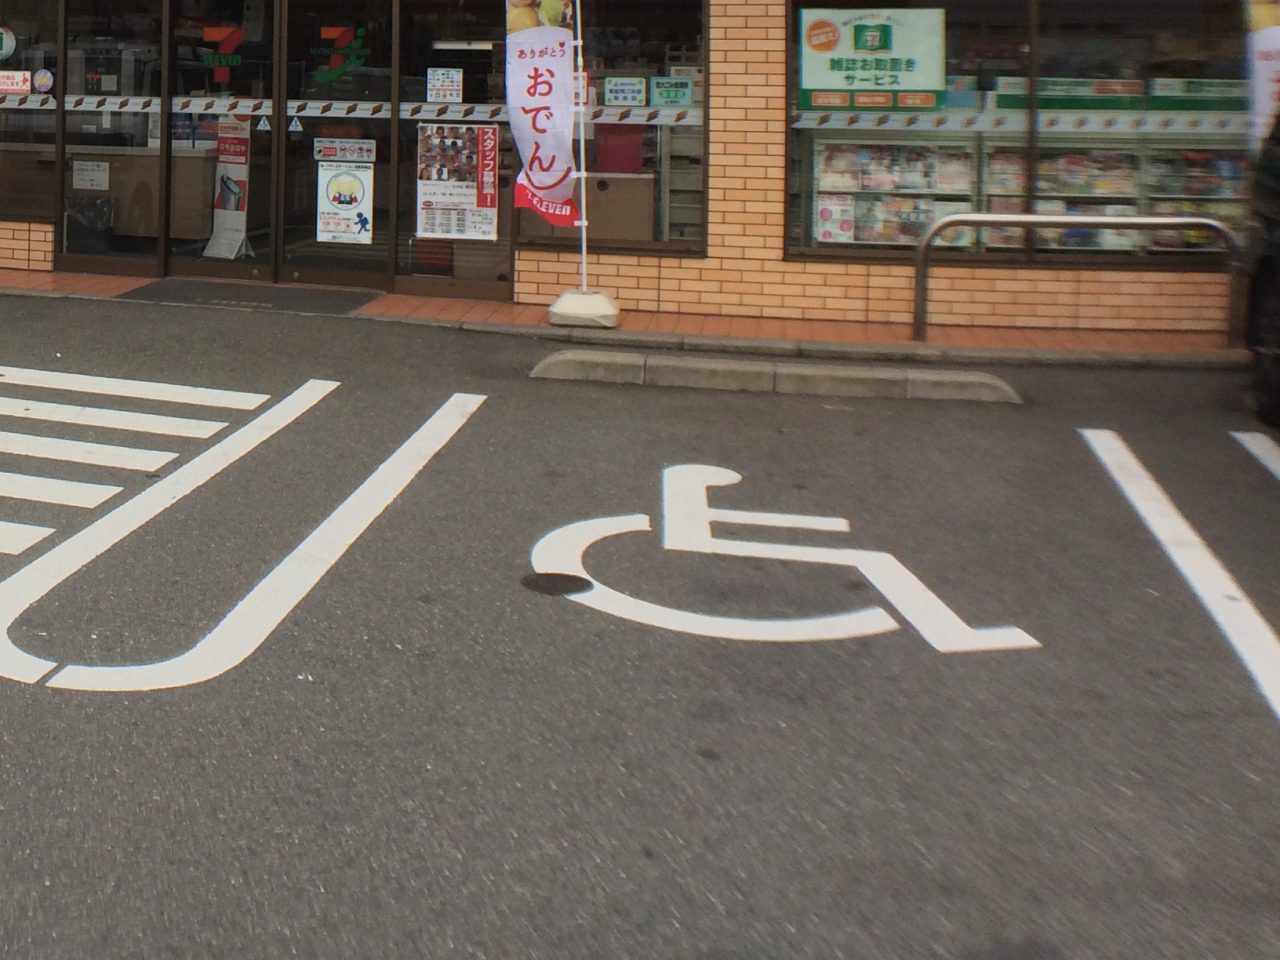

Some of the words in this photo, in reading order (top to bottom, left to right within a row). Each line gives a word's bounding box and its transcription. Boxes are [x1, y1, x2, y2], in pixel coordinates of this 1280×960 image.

[517, 46, 567, 60] ありがとう
[844, 74, 901, 86] サービス
[521, 66, 556, 173] おでん
